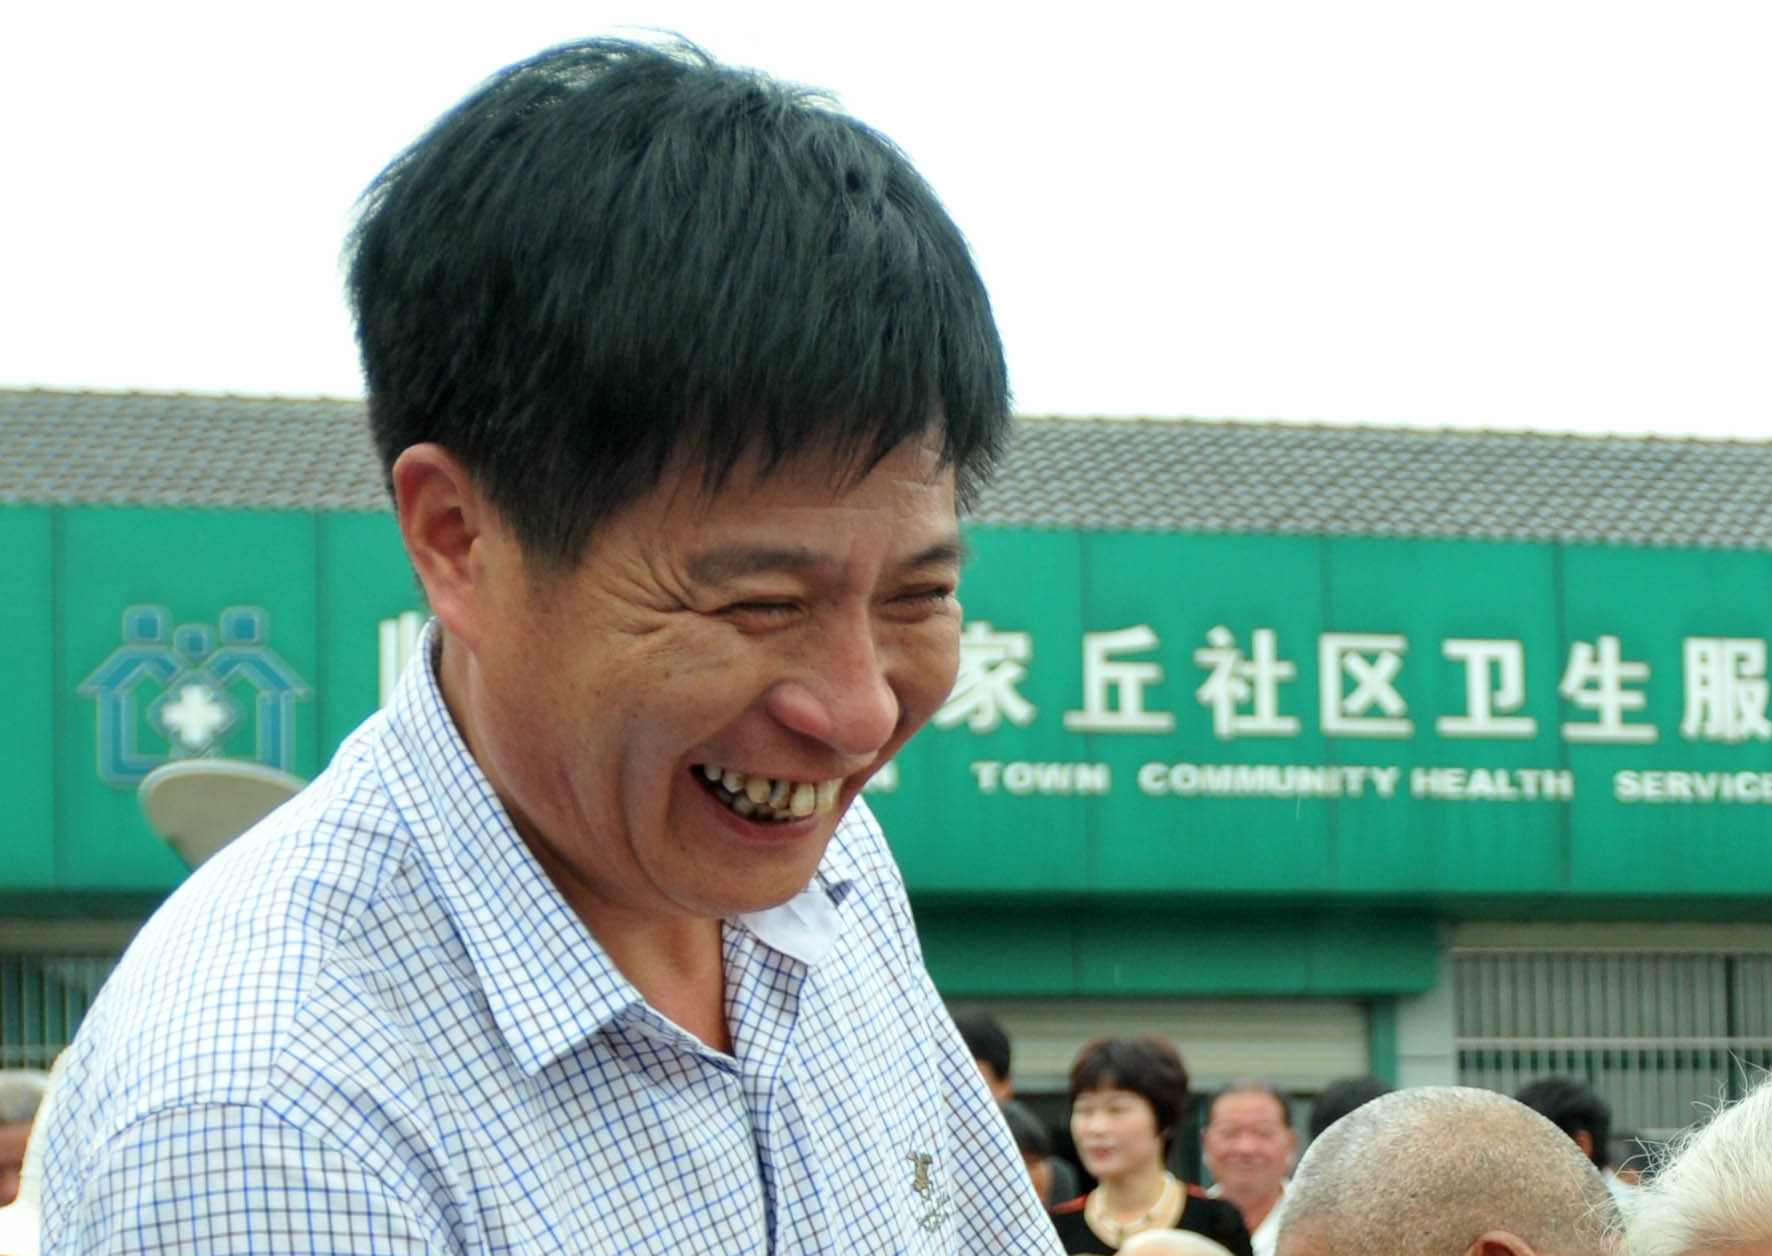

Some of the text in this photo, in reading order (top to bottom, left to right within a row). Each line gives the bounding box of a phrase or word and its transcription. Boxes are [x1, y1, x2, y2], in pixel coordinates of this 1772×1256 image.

[974, 762, 1108, 794] TOWN
[1140, 764, 1397, 797] COMMUNITY
[1412, 766, 1571, 799] HEALTH
